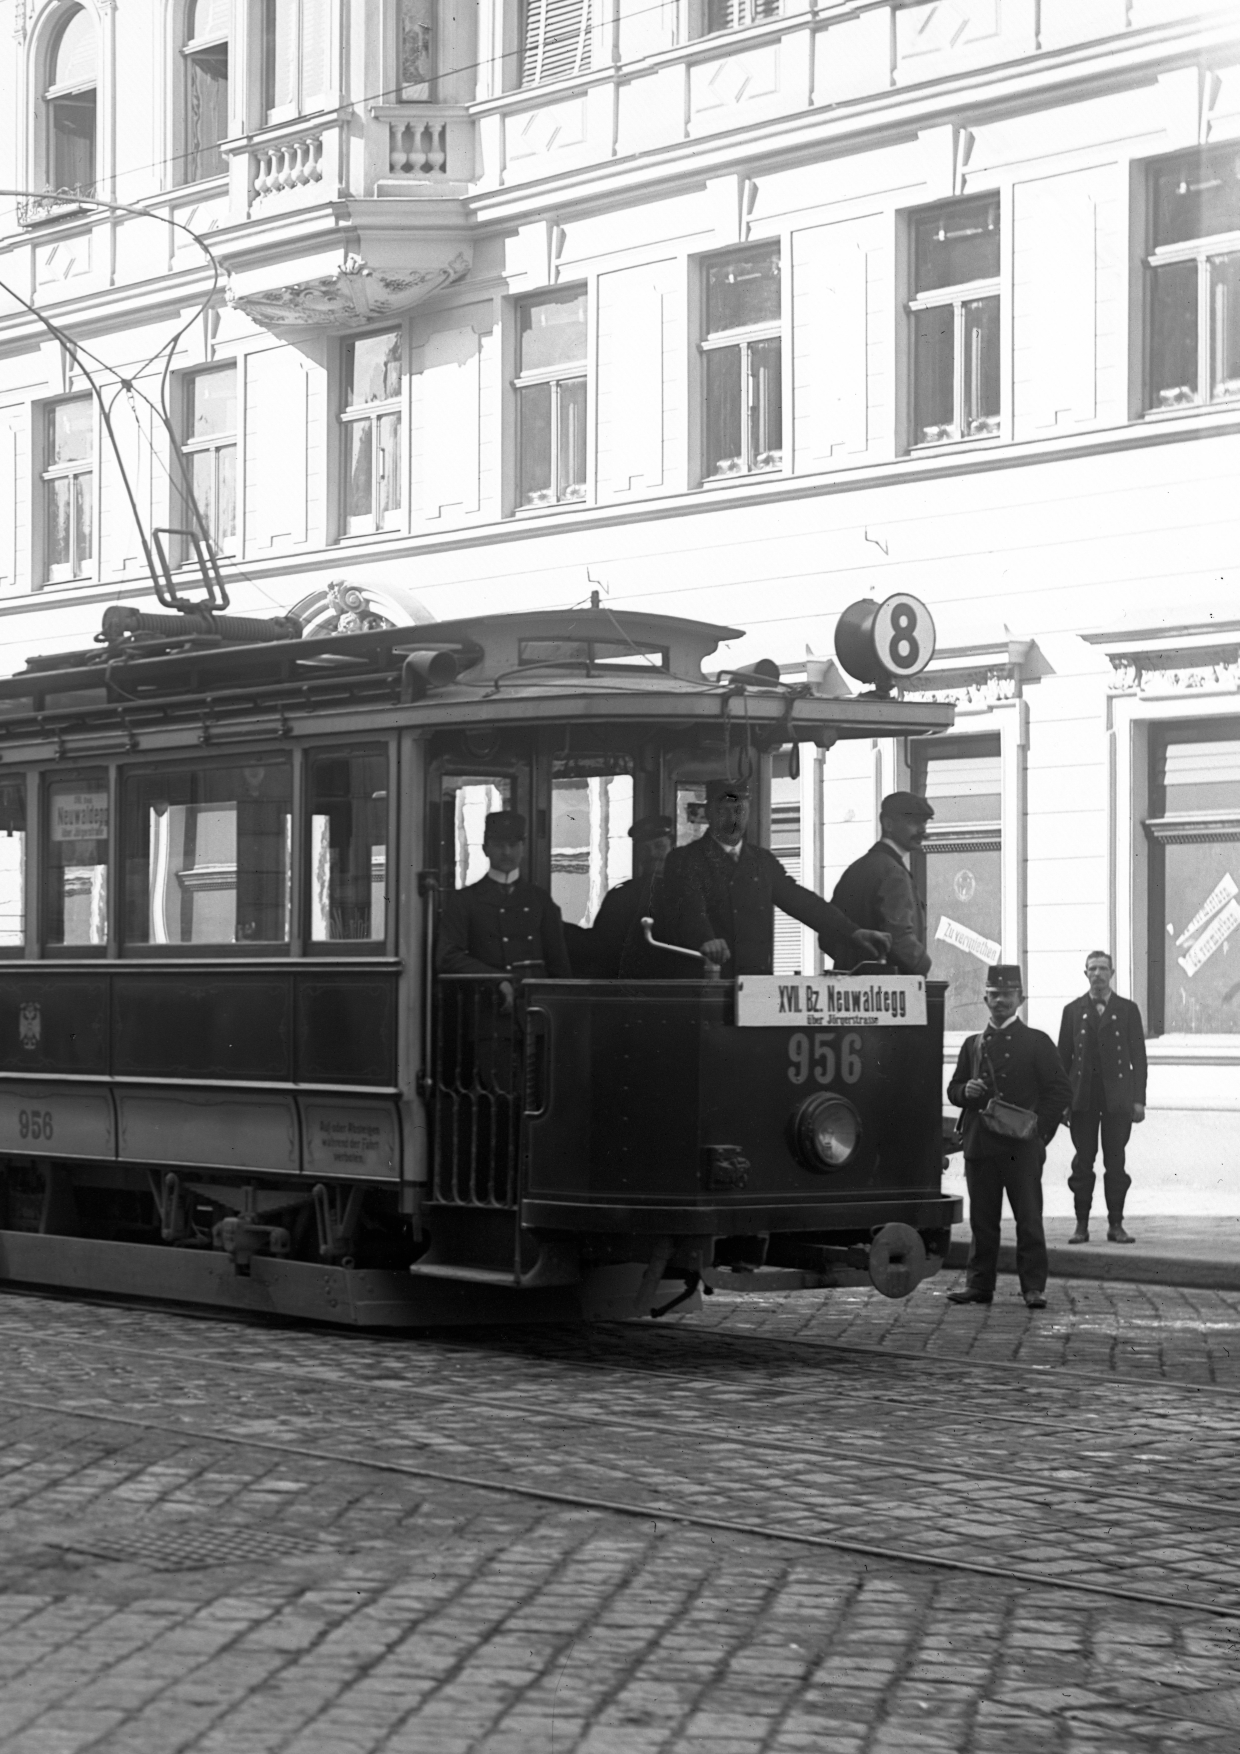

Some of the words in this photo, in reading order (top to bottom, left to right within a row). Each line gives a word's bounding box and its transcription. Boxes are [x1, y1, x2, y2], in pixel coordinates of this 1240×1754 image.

[889, 602, 920, 669] 8
[806, 985, 823, 1013] Bz.
[827, 984, 906, 1018] Neuwaldegg
[807, 1014, 824, 1025] über
[787, 1032, 862, 1084] 956
[19, 1109, 53, 1140] 956
